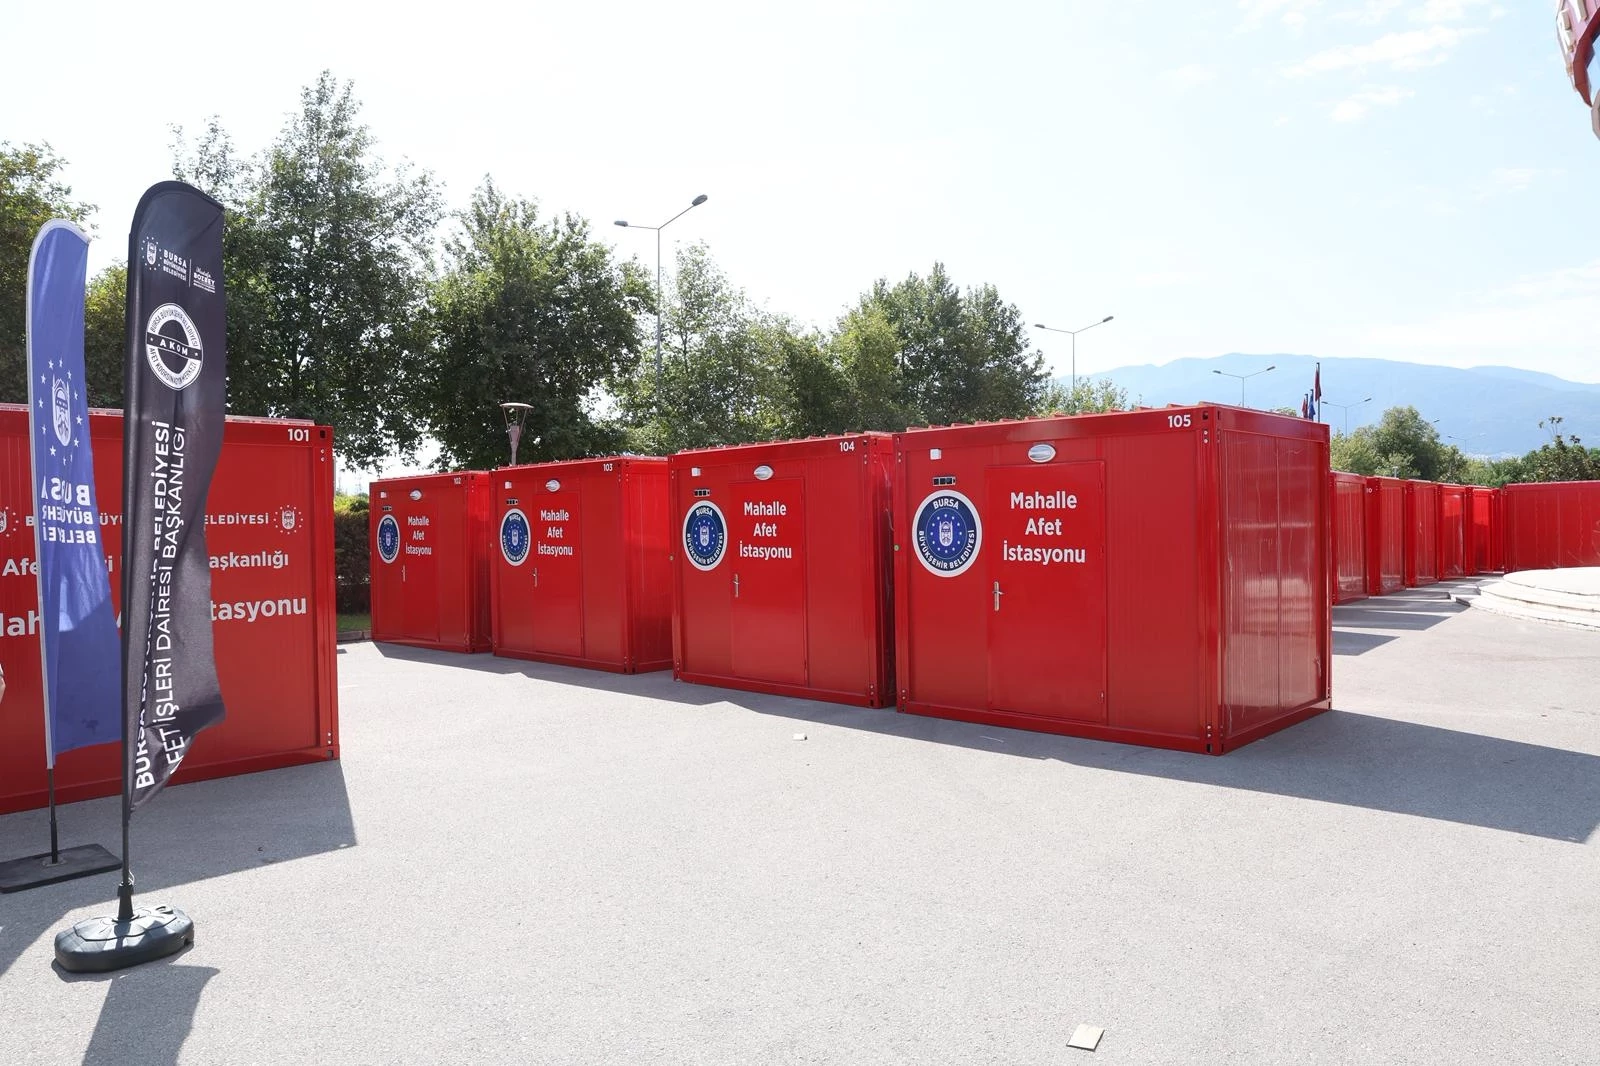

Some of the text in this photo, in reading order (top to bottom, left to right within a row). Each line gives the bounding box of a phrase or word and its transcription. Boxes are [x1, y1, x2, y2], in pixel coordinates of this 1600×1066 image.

[164, 249, 187, 268] BURSA
[160, 338, 188, 356] AKOM
[1168, 414, 1192, 428] 105
[288, 428, 310, 442] 101
[840, 442, 855, 452] 104
[603, 464, 613, 472] 103
[932, 498, 960, 510] BURSA
[1010, 491, 1078, 509] Mahalle
[540, 510, 569, 521] Mahalle
[696, 507, 713, 517] BURSA
[744, 501, 786, 516] Mahalle
[408, 516, 430, 526] Mahalle
[1025, 518, 1062, 536] Afet
[412, 530, 424, 540] Afet
[547, 527, 563, 538] Afet
[754, 523, 777, 537] Afet
[538, 541, 573, 557] İstasyonu
[740, 540, 792, 560] İstasyonu
[918, 530, 975, 569] BÜYÜKŞEHİR BELEDİYESİ
[1003, 540, 1086, 566] İstasyonu
[2, 550, 289, 577] Afe aşkanlığı
[210, 598, 307, 622] tasyonu
[152, 658, 180, 723] İŞLERİ
